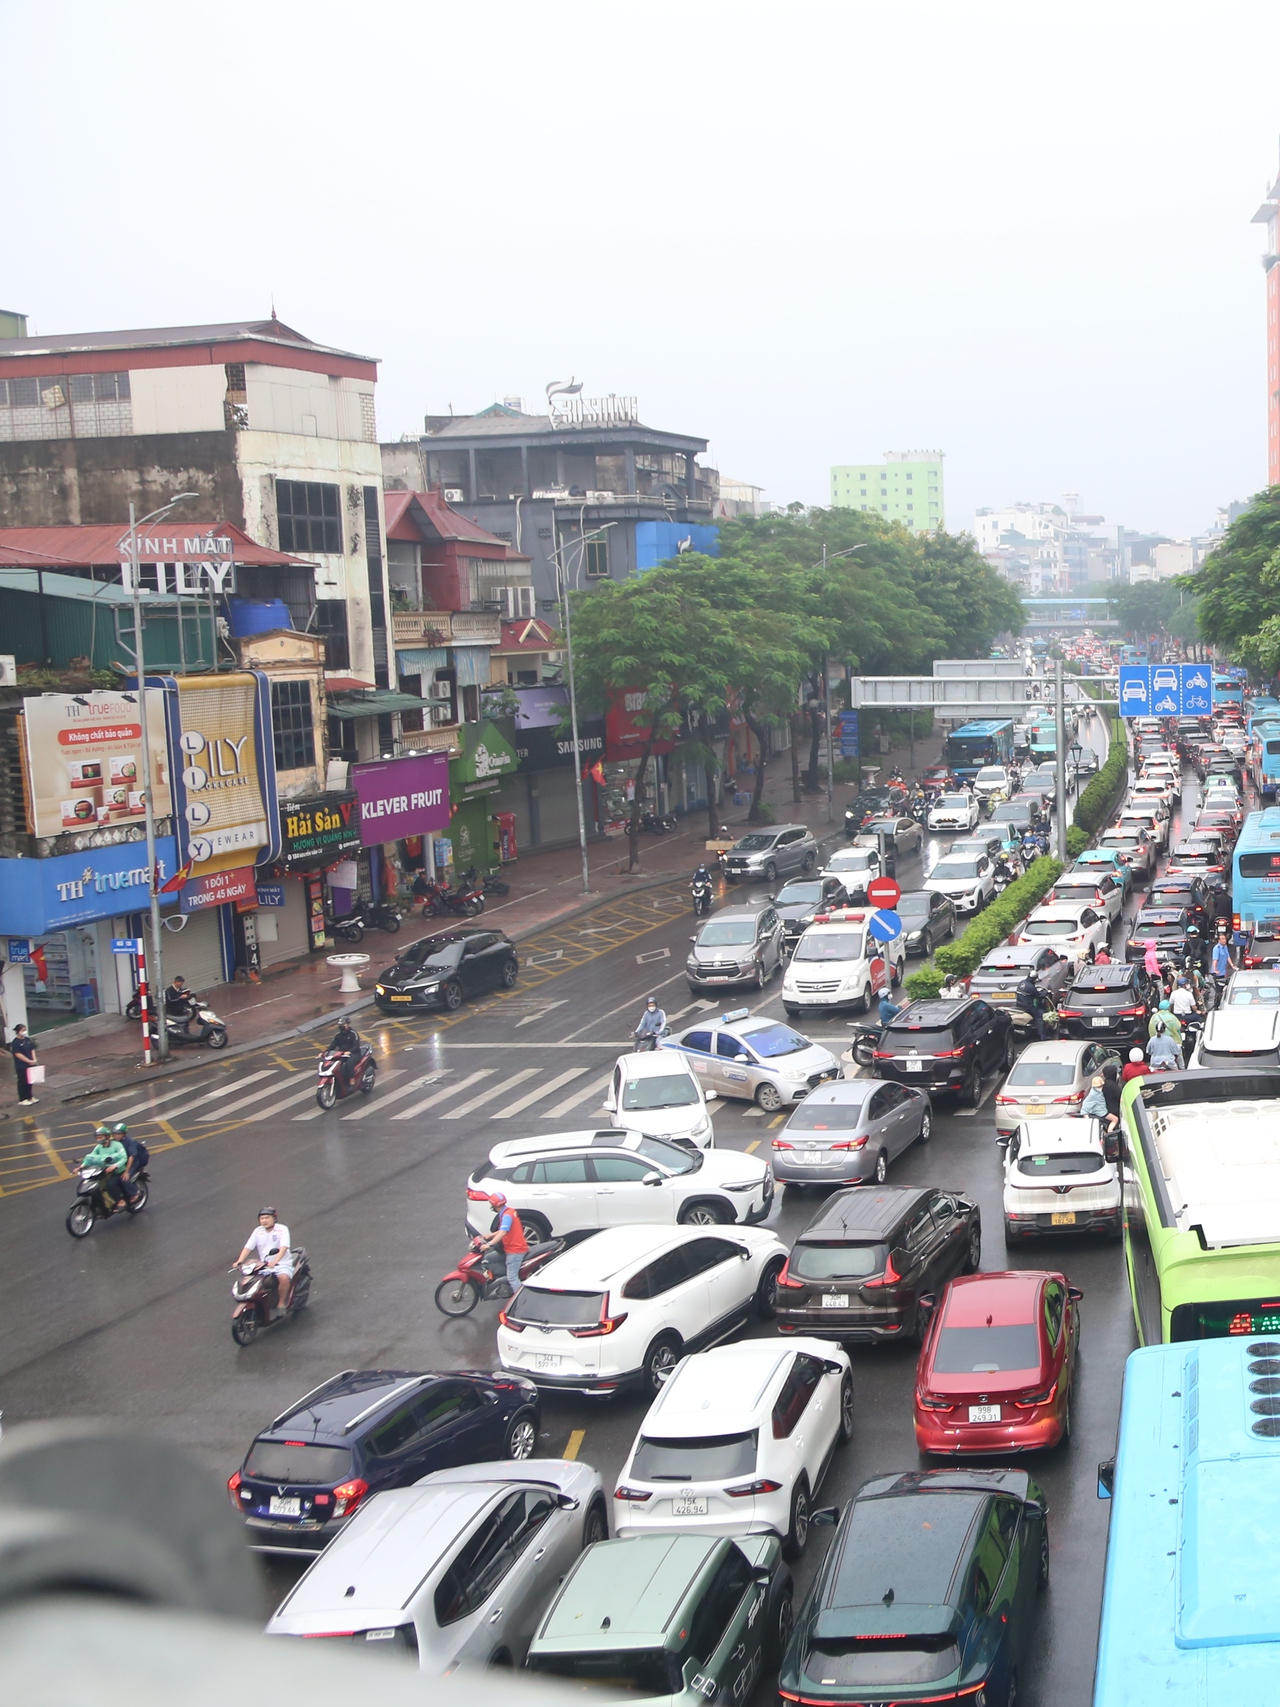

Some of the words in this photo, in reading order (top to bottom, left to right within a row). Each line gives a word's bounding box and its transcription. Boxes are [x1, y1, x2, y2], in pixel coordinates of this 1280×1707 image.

[120, 533, 177, 554] KÍNH
[184, 531, 231, 554] MẮT
[121, 561, 232, 595] LILY
[68, 732, 90, 742] Không
[90, 729, 104, 740] chất
[104, 728, 117, 738] bảo
[117, 727, 133, 738] quản
[361, 795, 408, 820] KLEVER
[411, 788, 443, 810] FRUIT
[287, 812, 313, 838] Hải
[315, 807, 341, 832] Sản
[57, 880, 84, 902] TH
[94, 859, 167, 893] truemat
[188, 892, 215, 907] TRONG
[216, 889, 225, 900] 45
[226, 883, 247, 895] NGÀY
[258, 894, 281, 905] LILY
[972, 1414, 997, 1422] 249.31
[978, 1406, 992, 1414] 99B
[676, 1505, 704, 1514] 426.94
